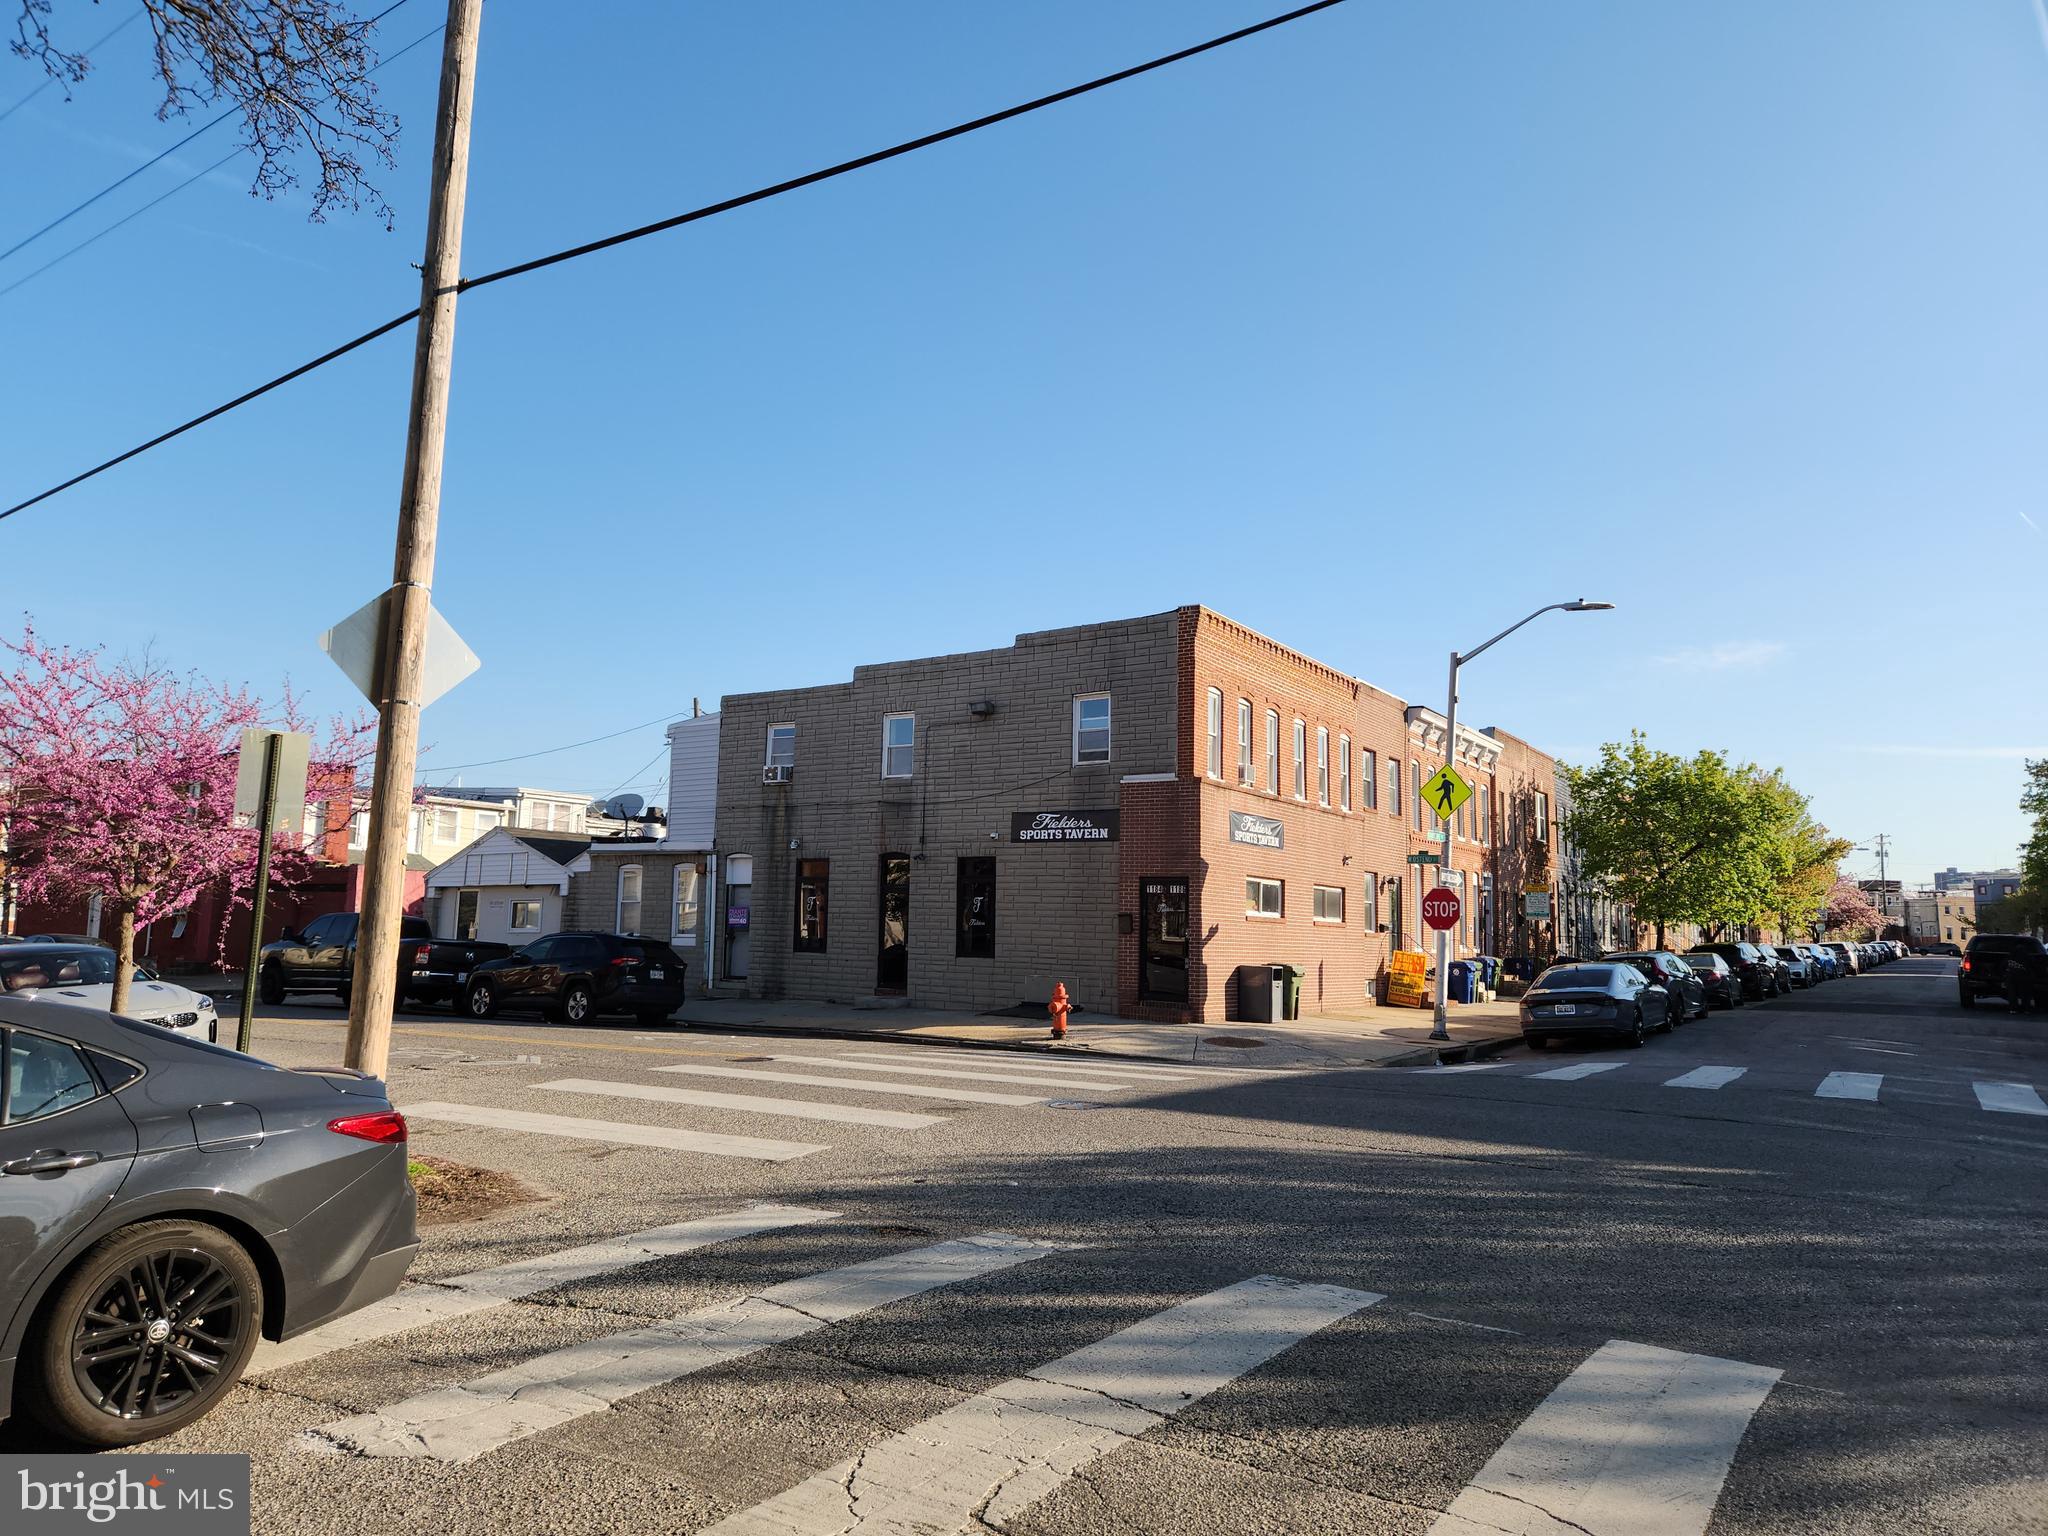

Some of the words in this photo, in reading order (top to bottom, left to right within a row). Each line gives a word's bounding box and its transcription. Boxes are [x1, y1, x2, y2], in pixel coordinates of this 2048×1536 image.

[1032, 813, 1093, 829] Fielders
[1020, 829, 1062, 840] SPORTS
[1064, 828, 1109, 839] TAVERN
[1424, 901, 1458, 917] STOP
